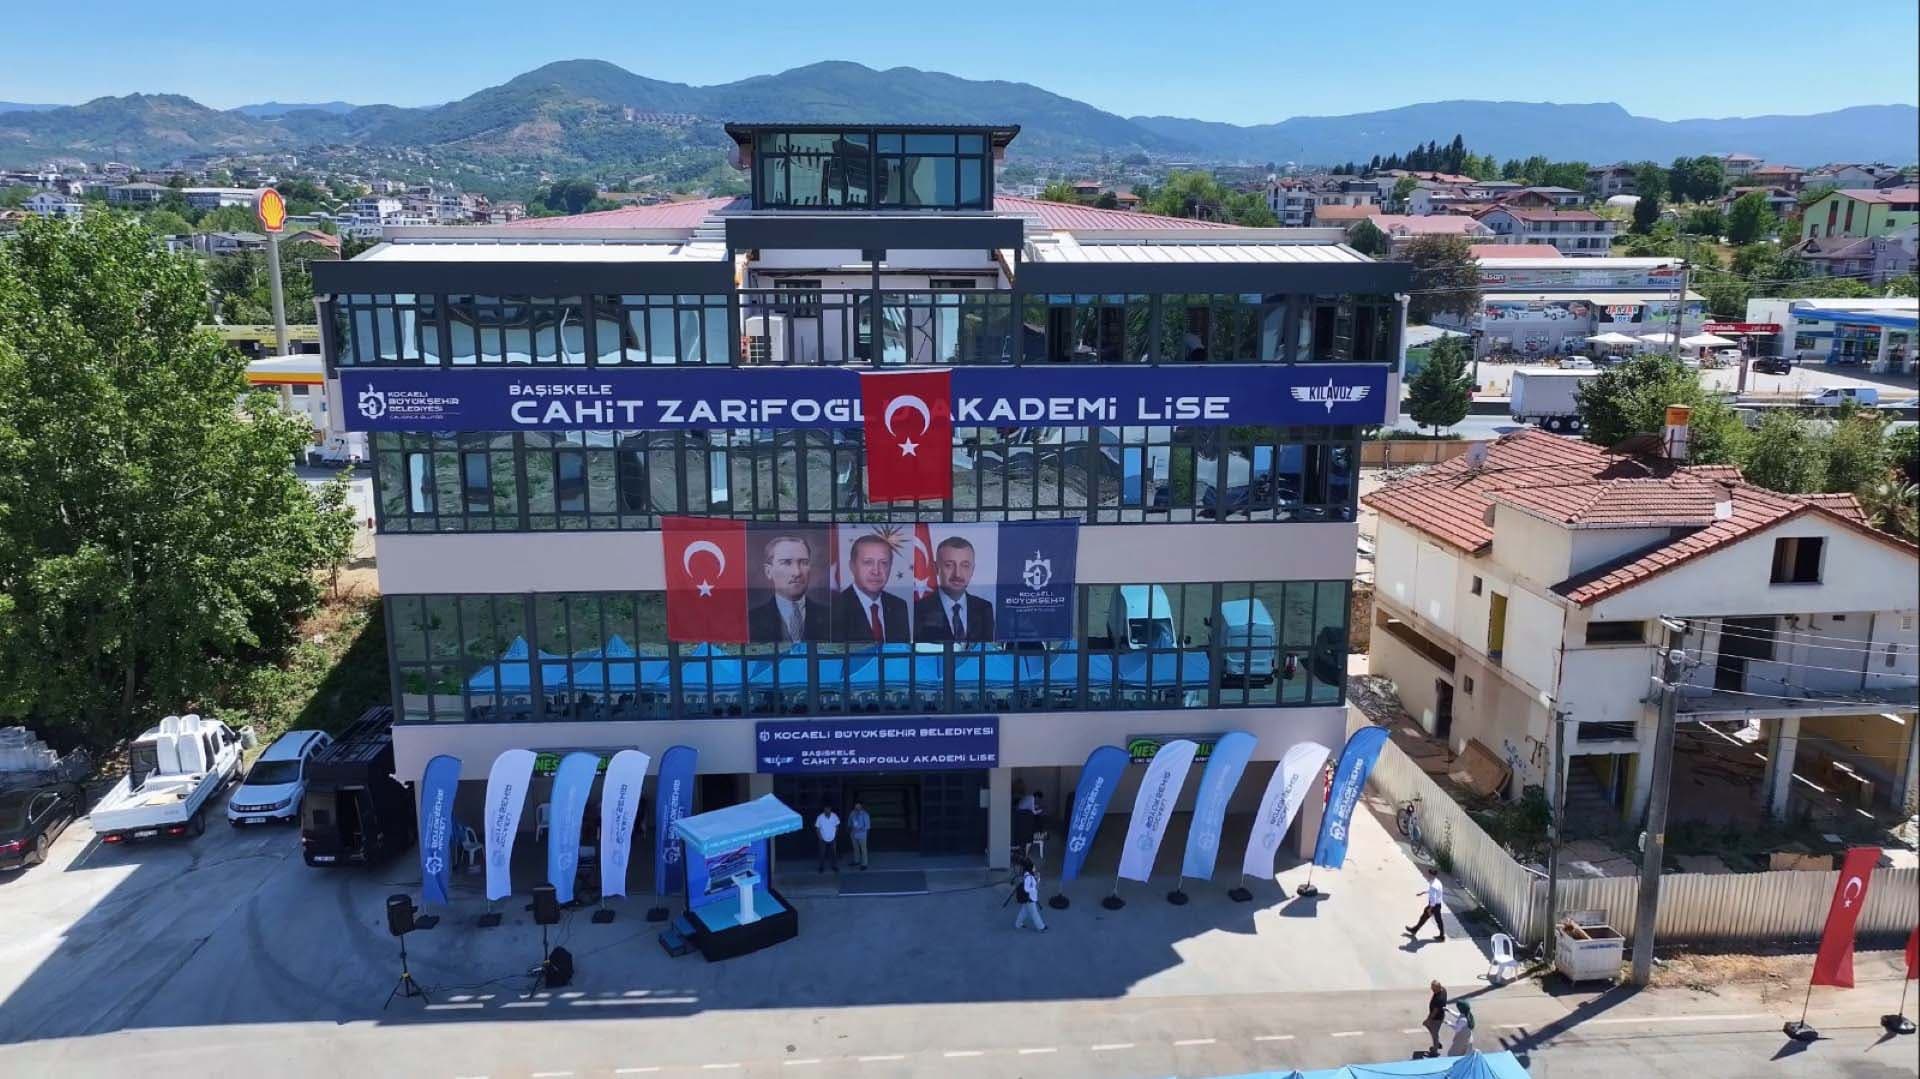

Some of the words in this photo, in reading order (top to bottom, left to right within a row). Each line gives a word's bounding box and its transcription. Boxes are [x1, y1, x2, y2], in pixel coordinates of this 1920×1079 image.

[509, 384, 613, 398] BAŞİSKELE
[1309, 386, 1353, 400] KILAVUZ
[656, 398, 866, 423] ZARİFOĞL
[949, 397, 1117, 422] KADEMİ
[1137, 396, 1230, 420] LİSE
